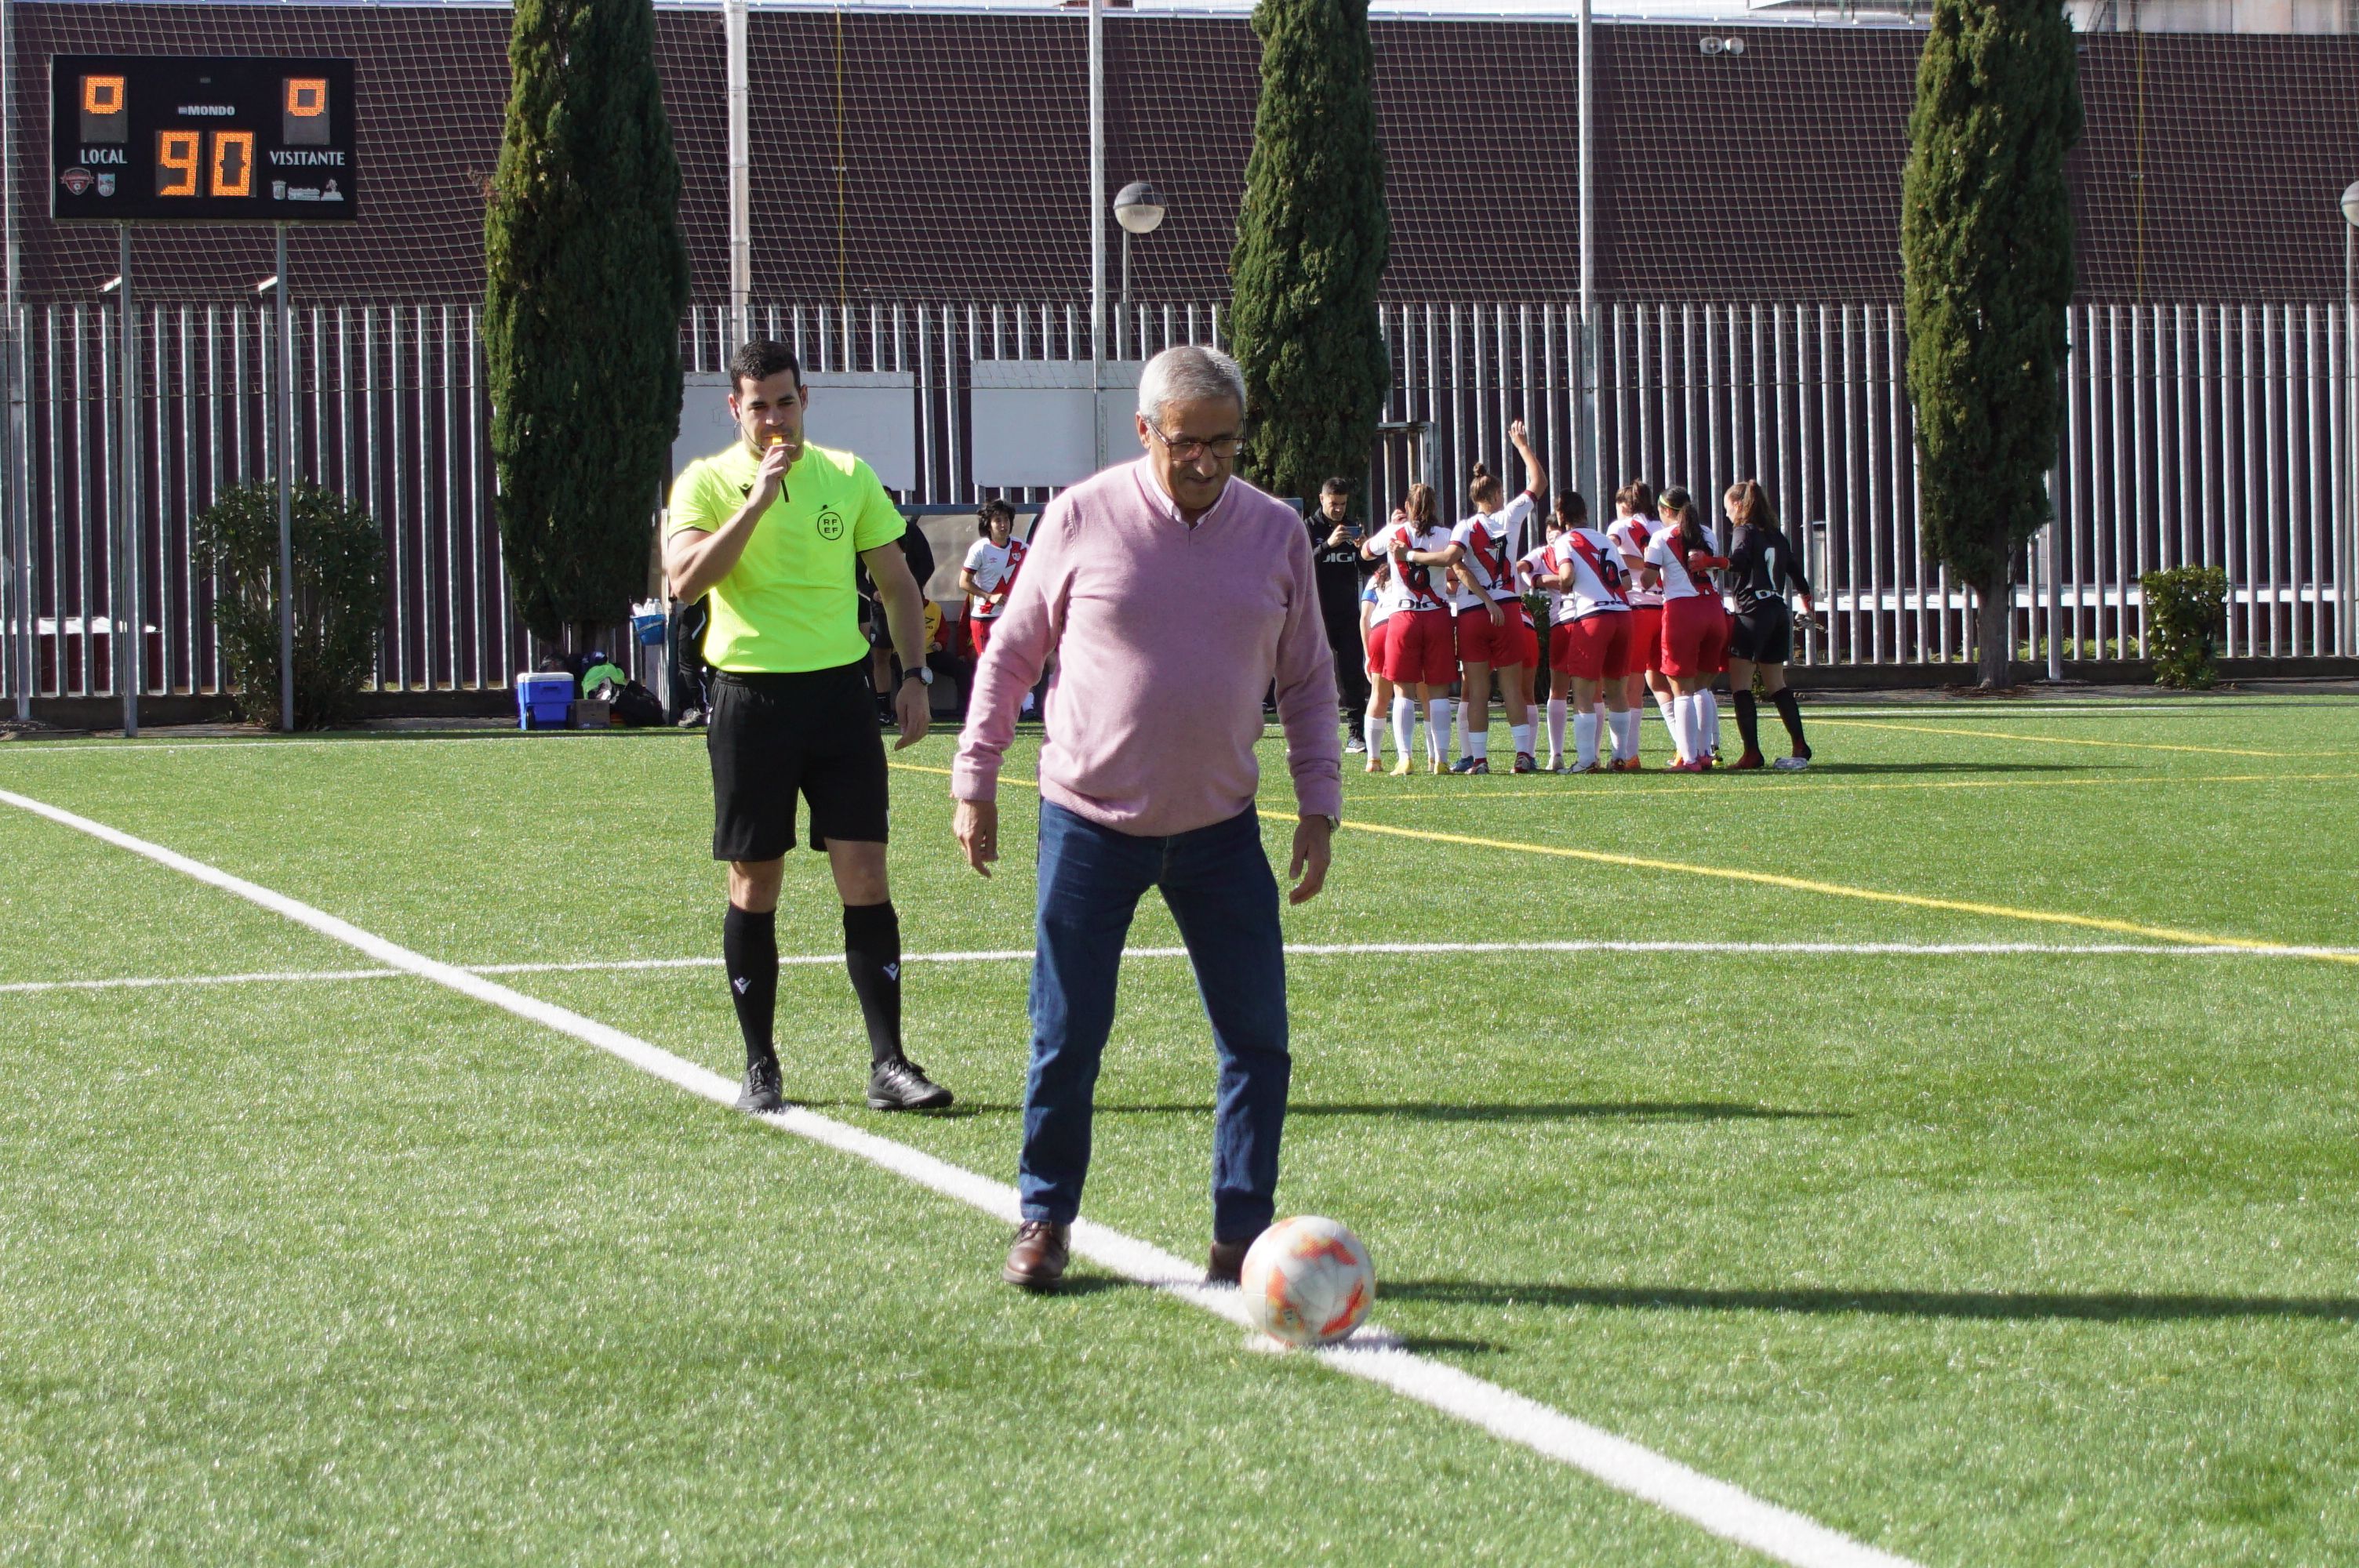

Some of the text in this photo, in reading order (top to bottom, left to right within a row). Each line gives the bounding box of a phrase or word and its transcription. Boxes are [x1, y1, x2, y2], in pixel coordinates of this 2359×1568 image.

[85, 76, 124, 114] 0
[187, 105, 235, 116] MONDO
[288, 79, 326, 117] 0
[81, 149, 128, 165] LOCAL
[159, 131, 254, 197] 90
[269, 151, 346, 165] VISITANTE
[1598, 548, 1622, 587] 6
